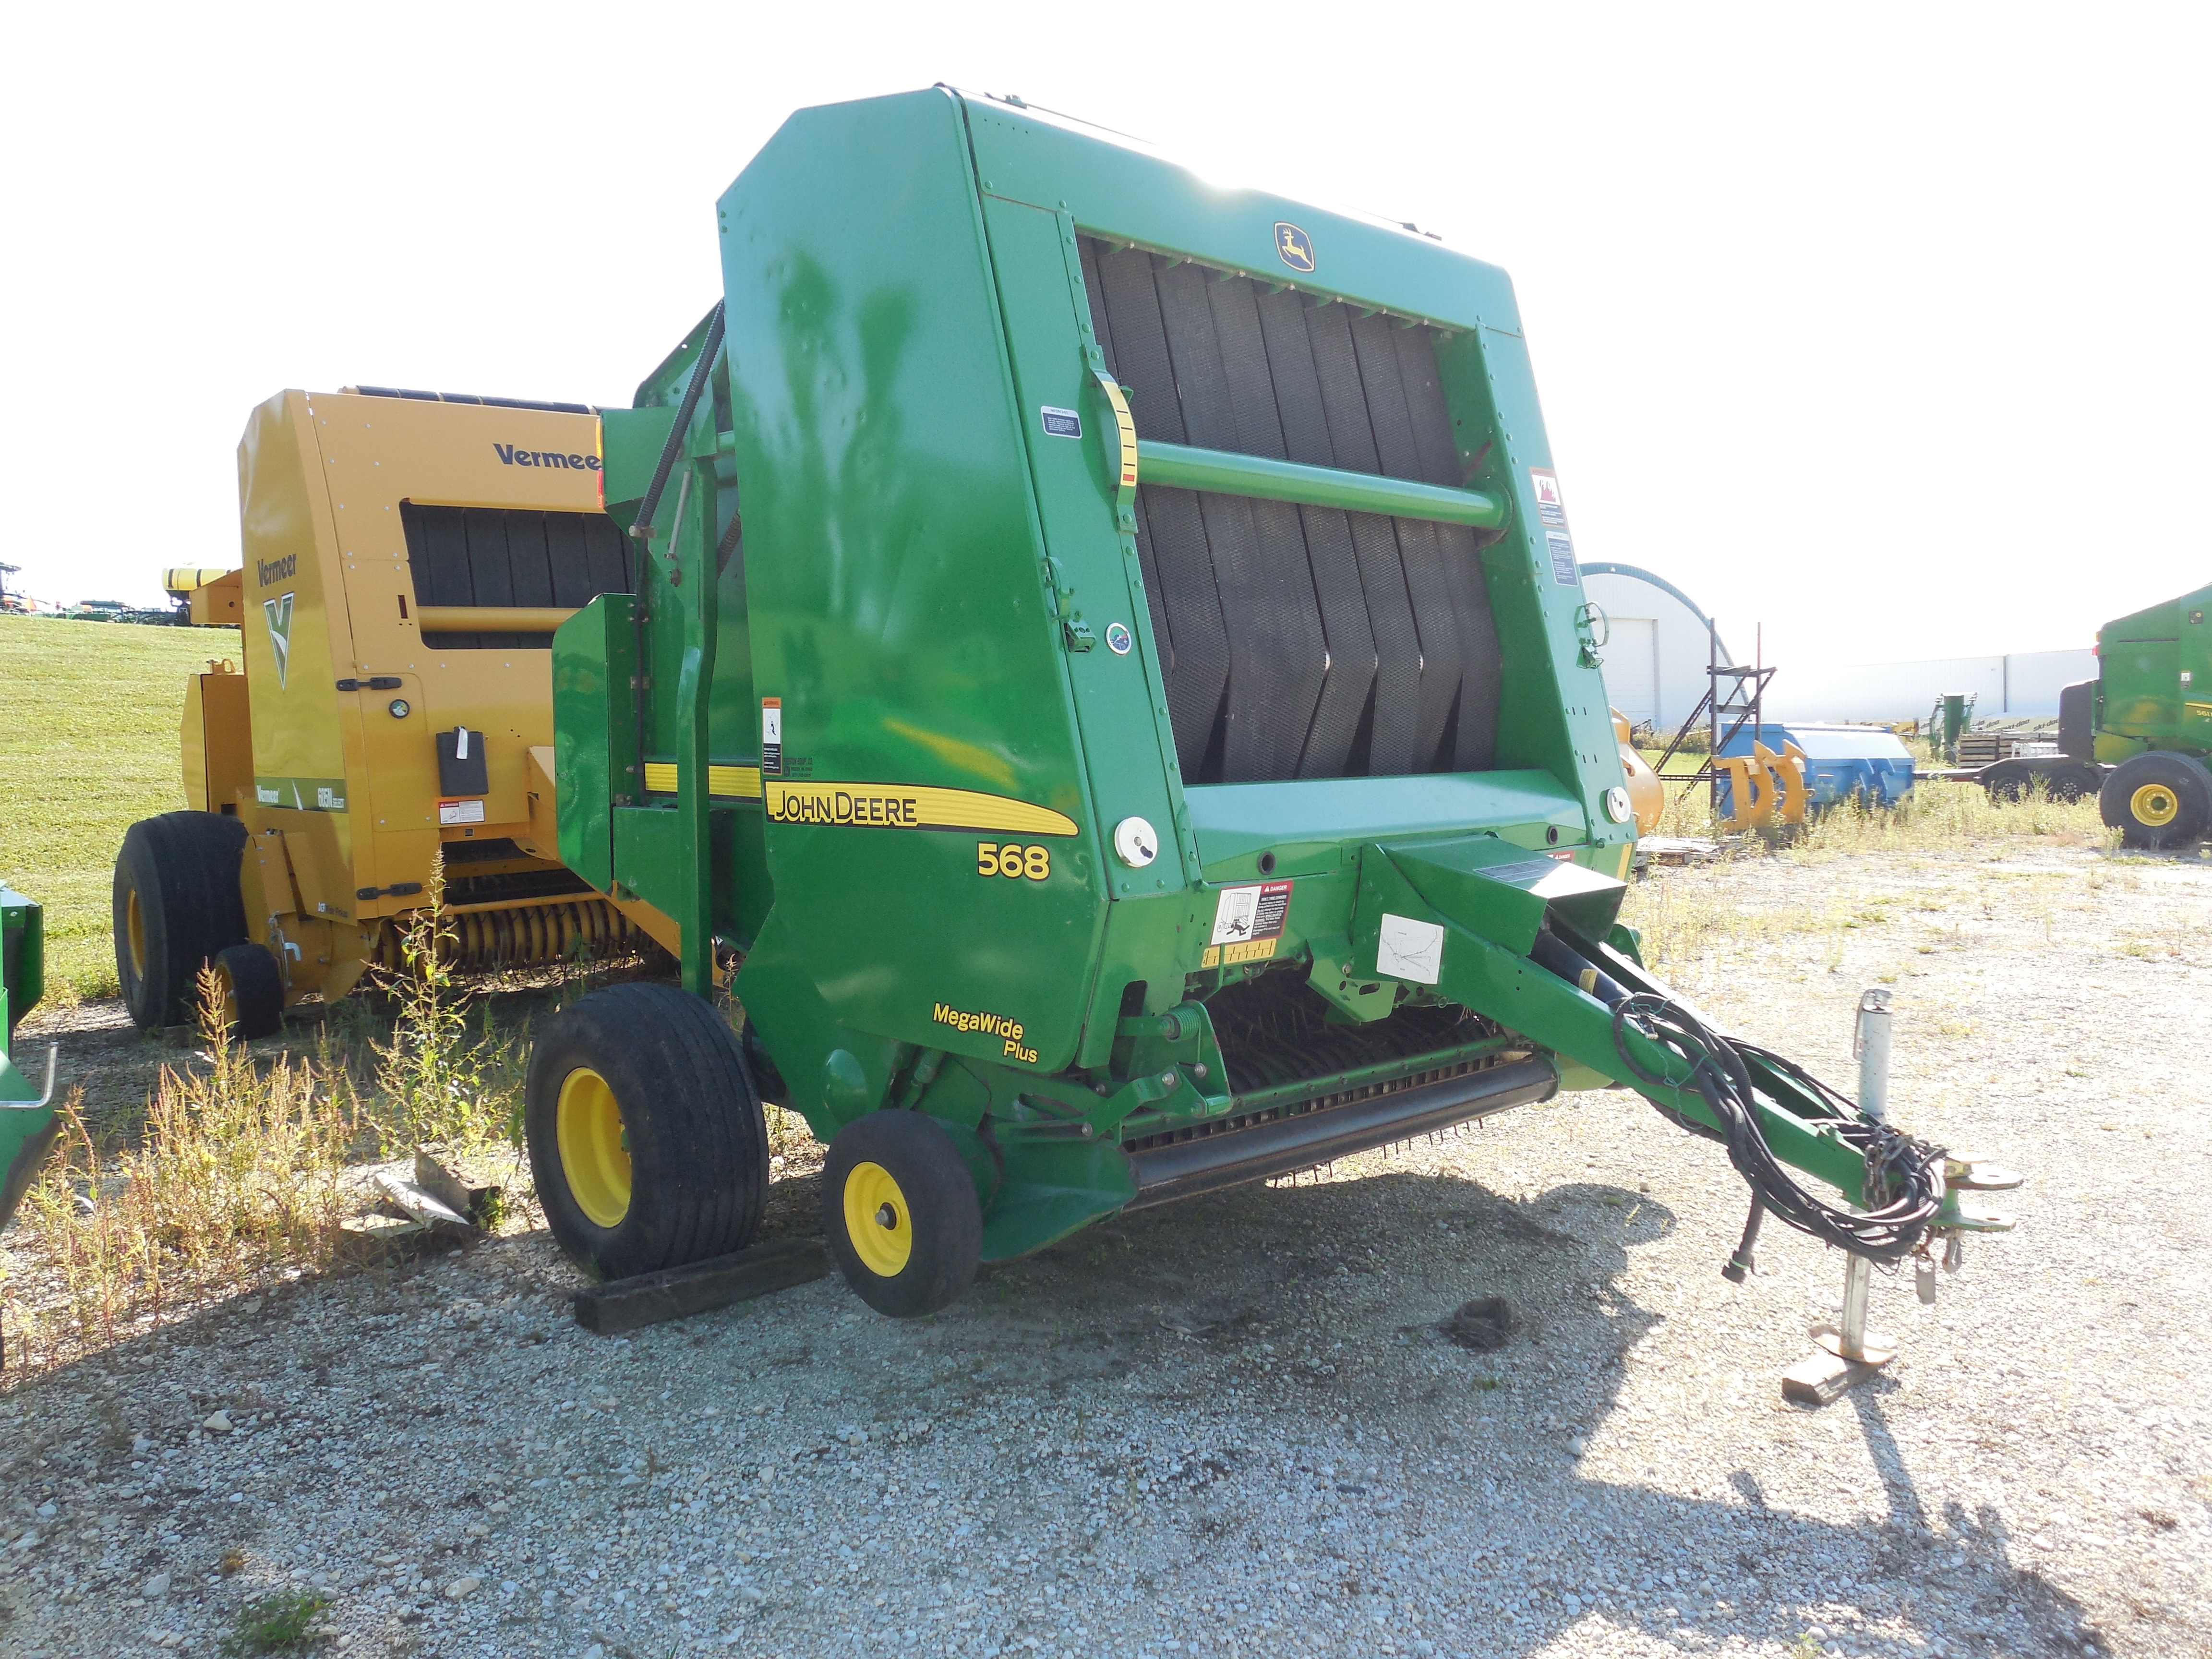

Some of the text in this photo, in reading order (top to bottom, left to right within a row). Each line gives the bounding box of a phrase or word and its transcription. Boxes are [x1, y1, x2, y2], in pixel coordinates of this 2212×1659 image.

[493, 443, 601, 471] Vermee
[257, 553, 296, 588] Vermeer
[775, 790, 918, 824] JOHN DEERE
[977, 842, 1050, 880] 568
[933, 1002, 1024, 1040] MegaWide
[1003, 1040, 1038, 1063] Plus
